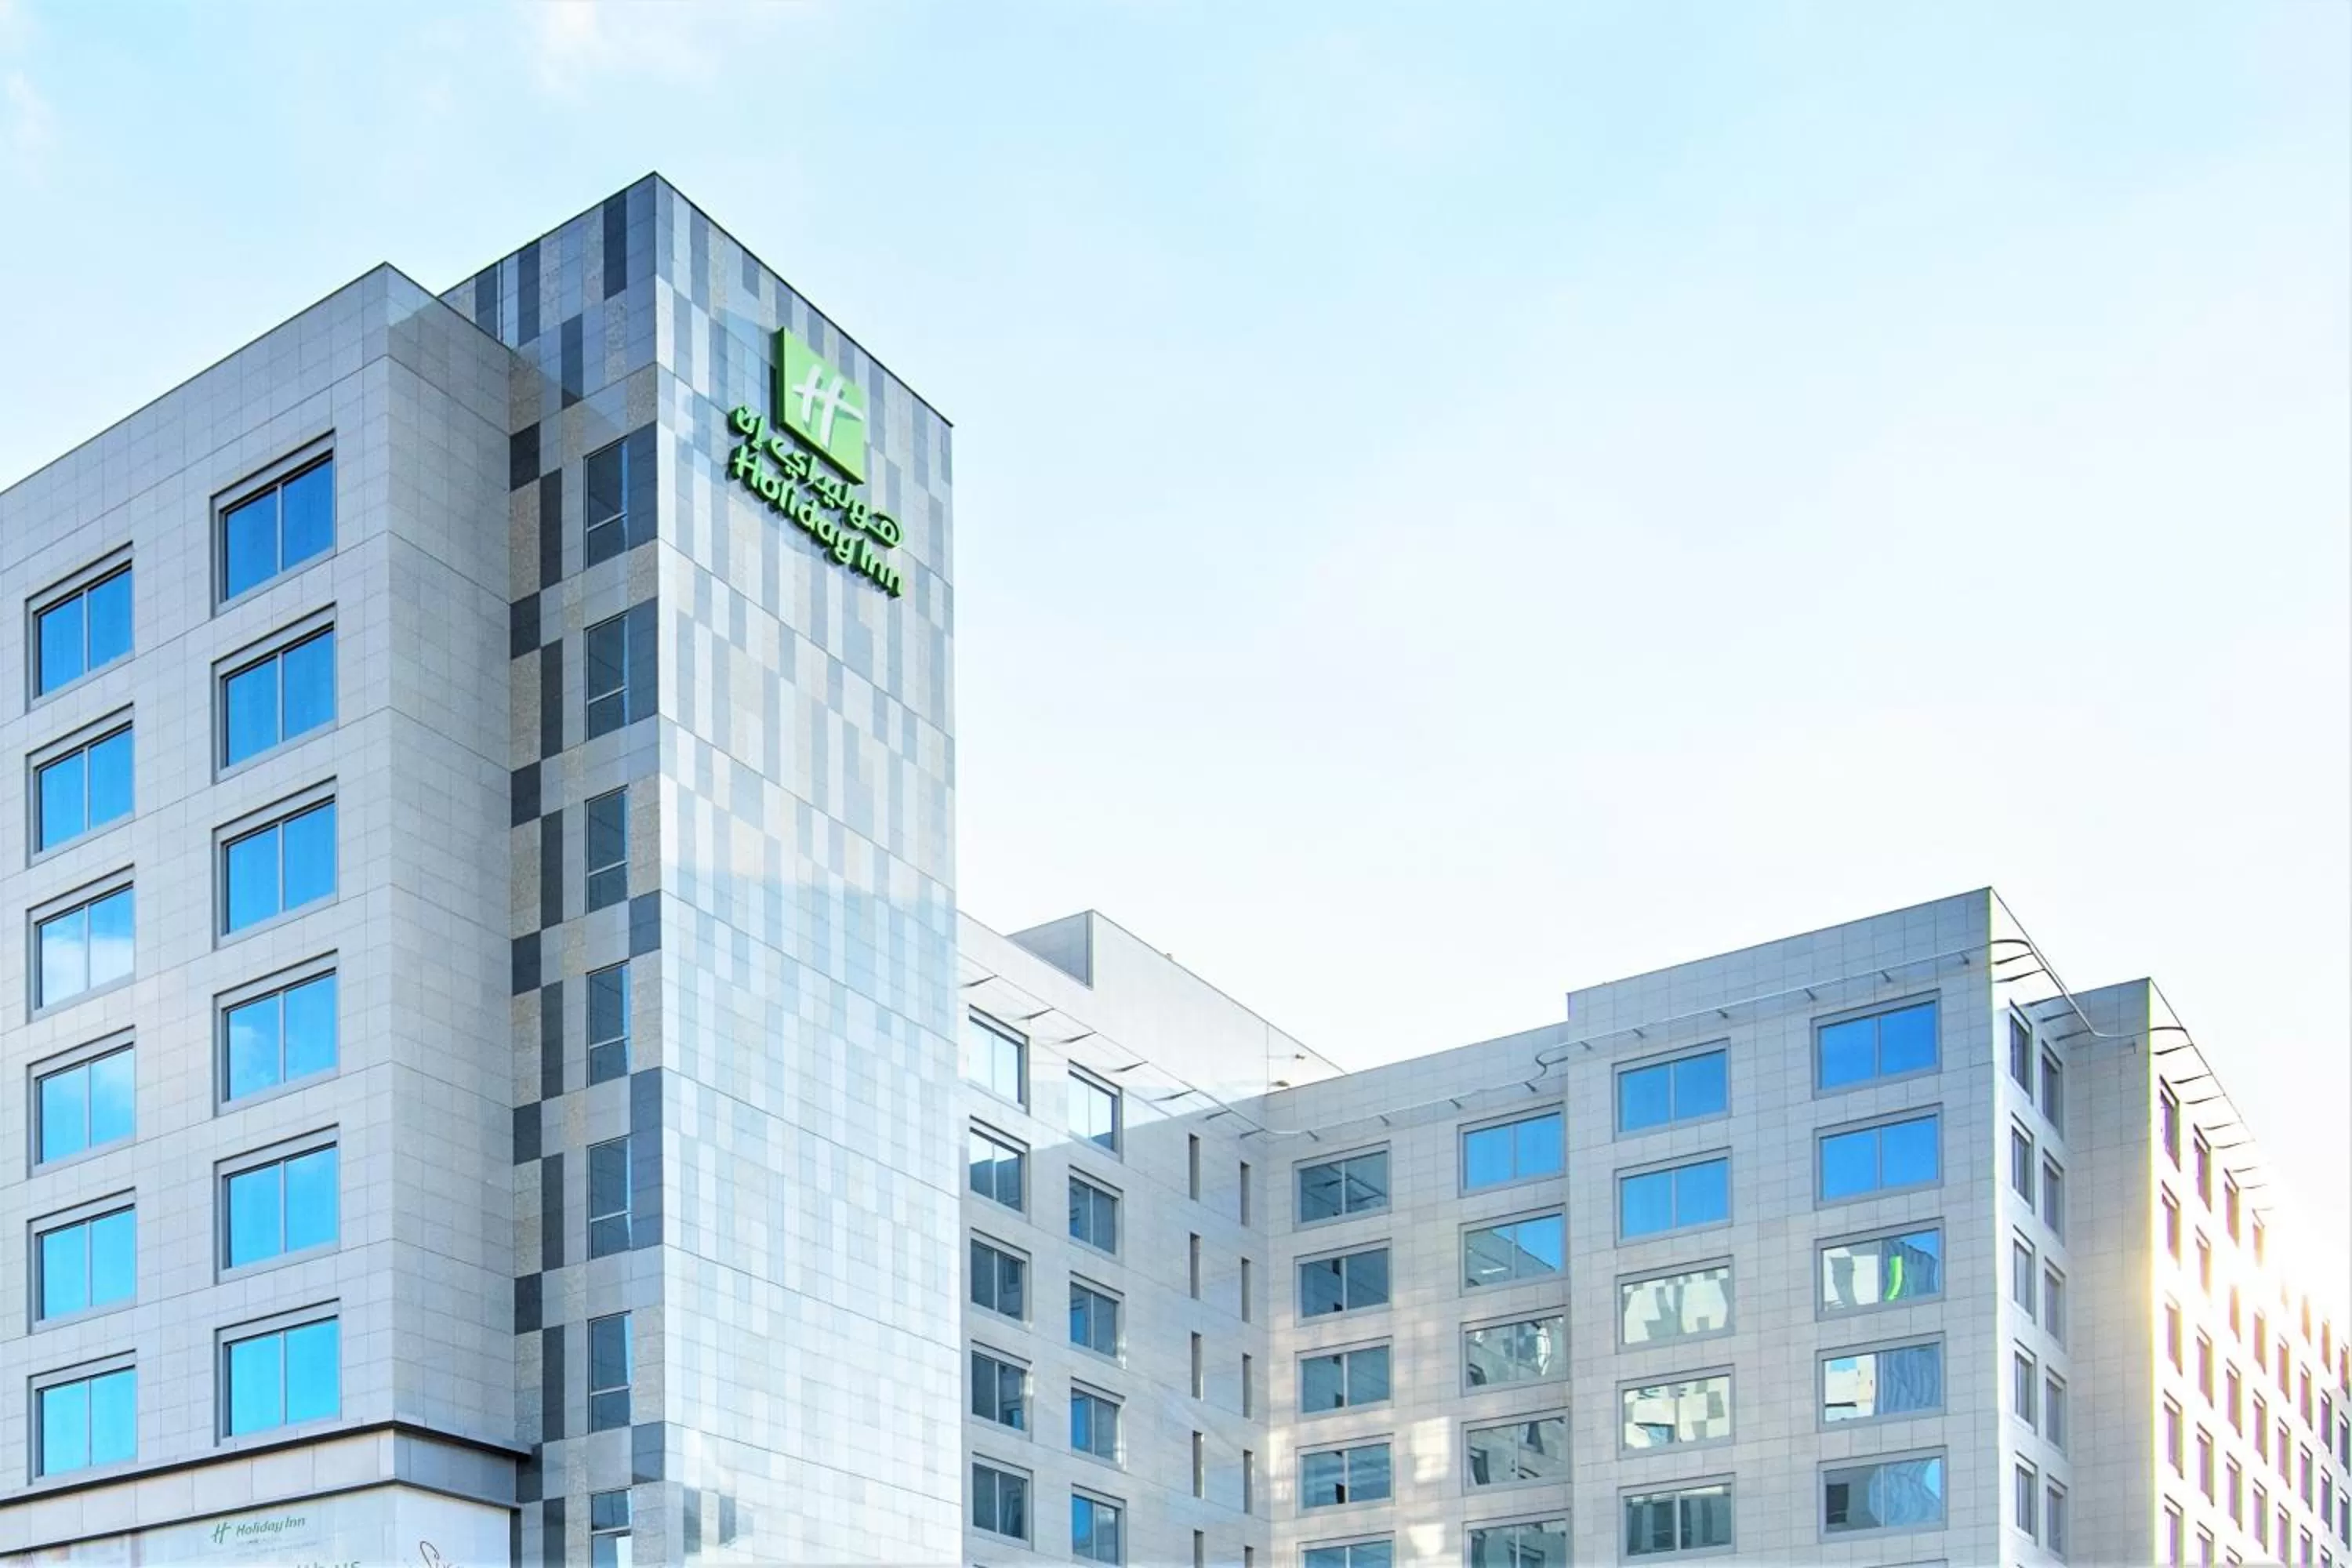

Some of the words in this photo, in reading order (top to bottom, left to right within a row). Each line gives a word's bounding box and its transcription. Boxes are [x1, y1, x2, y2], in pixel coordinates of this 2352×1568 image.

[731, 445, 855, 564] Holiday
[859, 538, 904, 597] Inn
[765, 436, 903, 547] هوليداي
[236, 1519, 282, 1537] Holiday
[285, 1515, 306, 1529] Inn
